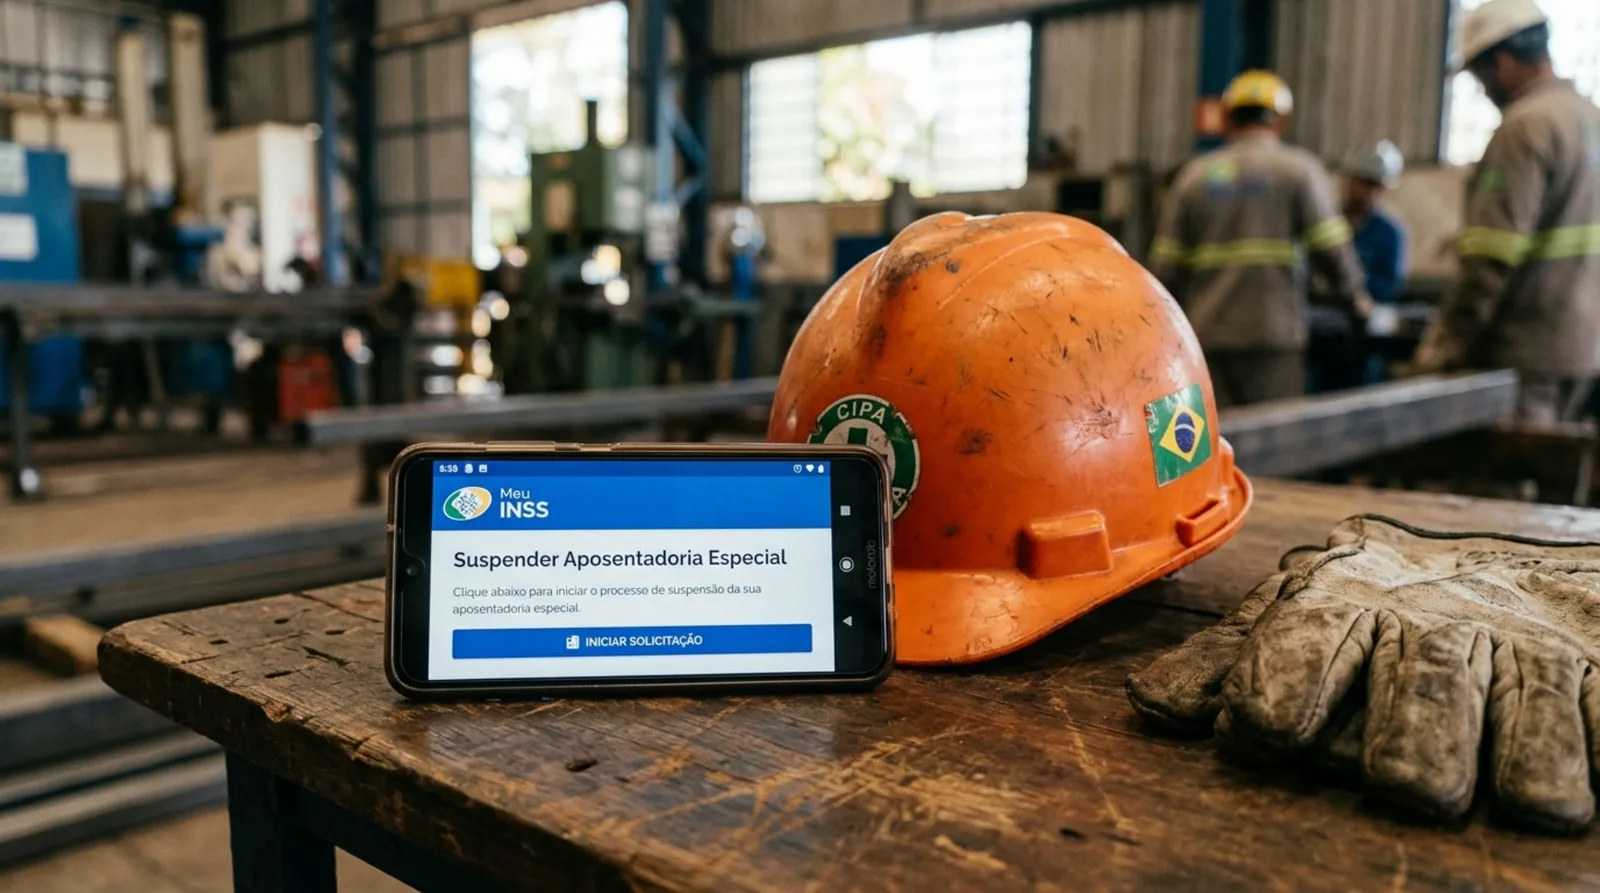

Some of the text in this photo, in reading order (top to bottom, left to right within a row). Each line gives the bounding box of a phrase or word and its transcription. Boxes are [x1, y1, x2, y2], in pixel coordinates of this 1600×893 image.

[837, 401, 886, 424] CIPA
[500, 488, 530, 499] Meu
[500, 501, 549, 518] INSS
[453, 549, 787, 571] Suspender Aposentadoria Especial
[453, 584, 762, 598] Clique abaixo para iniciar o processo de suspensão da sua
[452, 603, 581, 616] aposentadoria especial.
[585, 637, 627, 647] INICIAR
